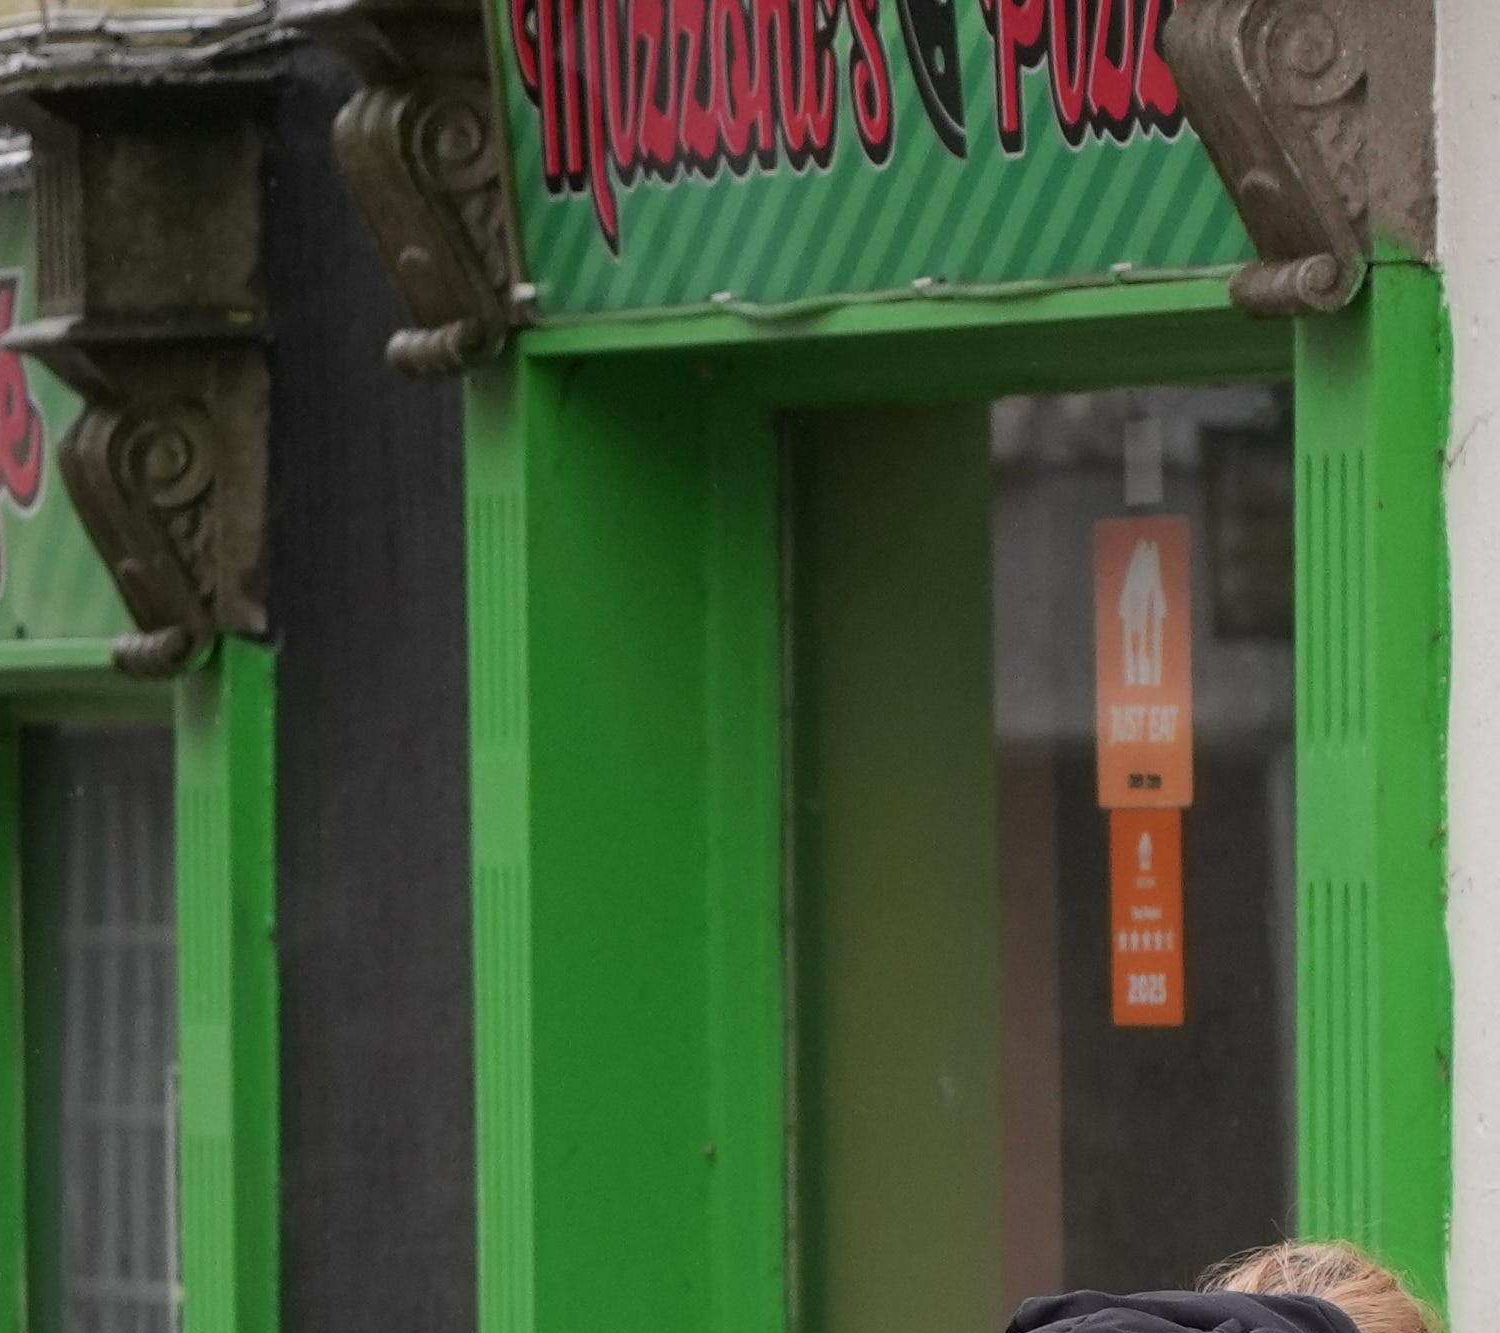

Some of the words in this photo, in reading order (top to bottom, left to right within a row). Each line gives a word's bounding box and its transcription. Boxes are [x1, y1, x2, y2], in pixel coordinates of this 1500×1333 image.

[985, 0, 1190, 157] Pizz
[1108, 704, 1146, 744] JUST
[1148, 704, 1180, 743] EAT
